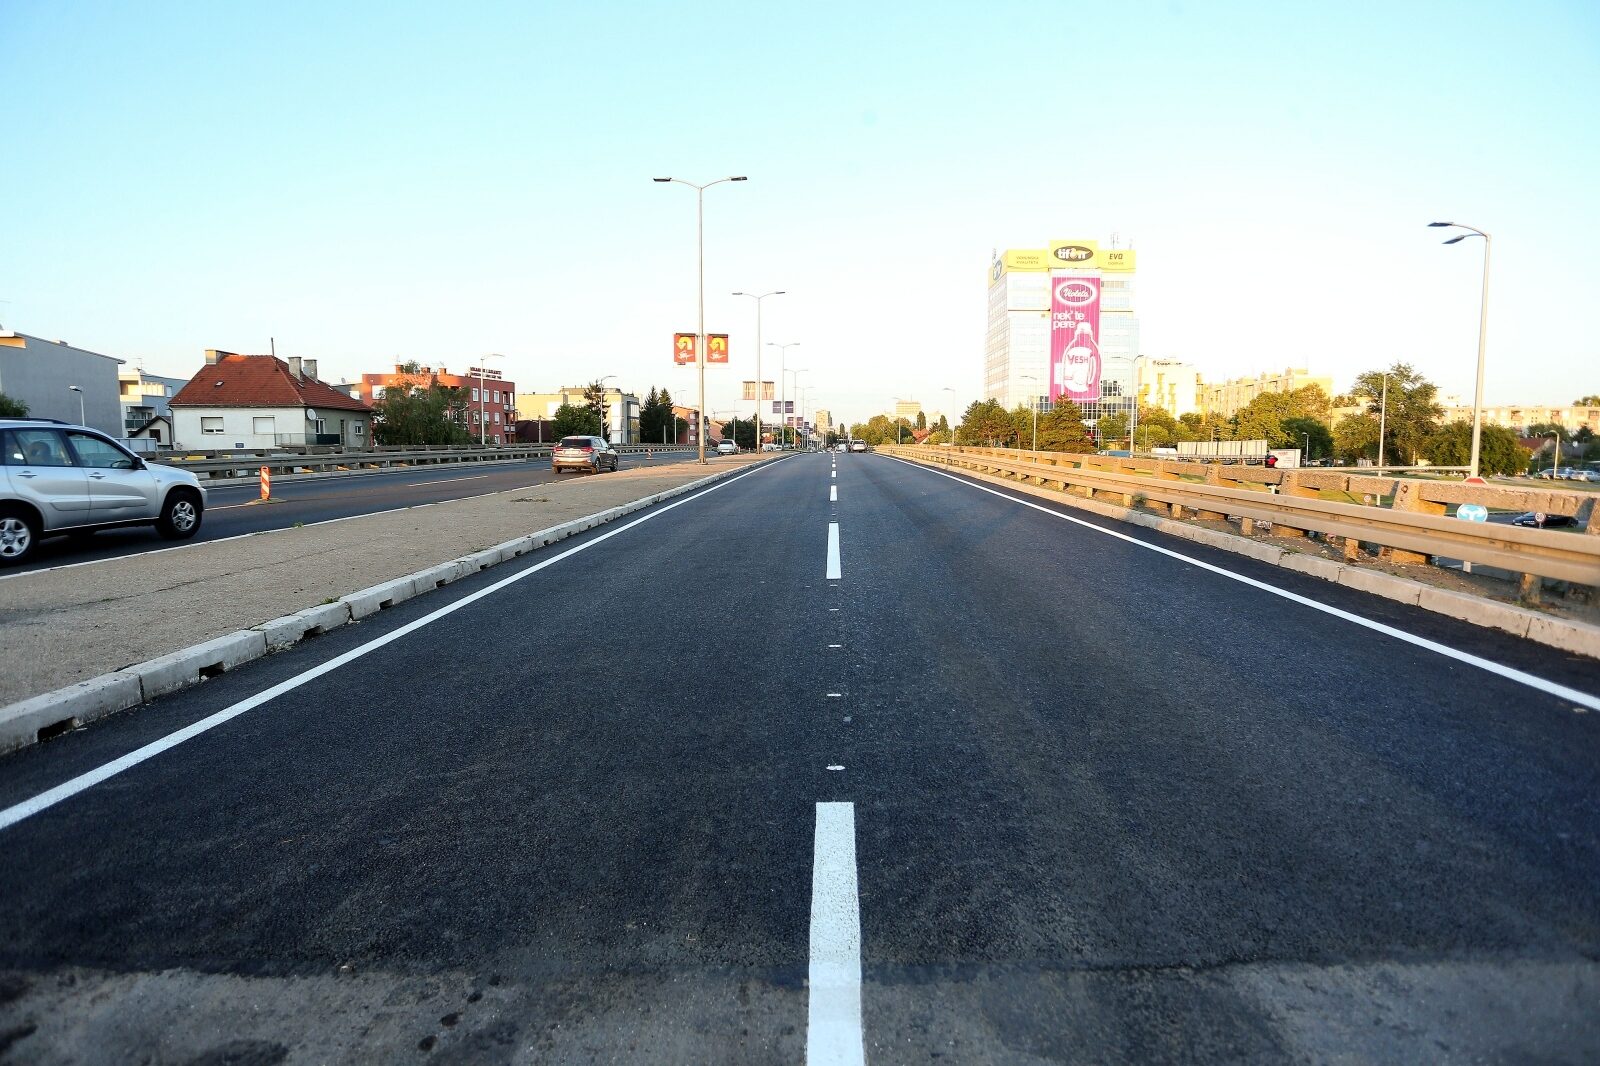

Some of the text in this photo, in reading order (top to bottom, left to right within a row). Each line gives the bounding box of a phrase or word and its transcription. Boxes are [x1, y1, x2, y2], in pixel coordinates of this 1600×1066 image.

[1057, 248, 1087, 259] tifon
[1075, 310, 1085, 320] te
[1053, 321, 1076, 330] pere
